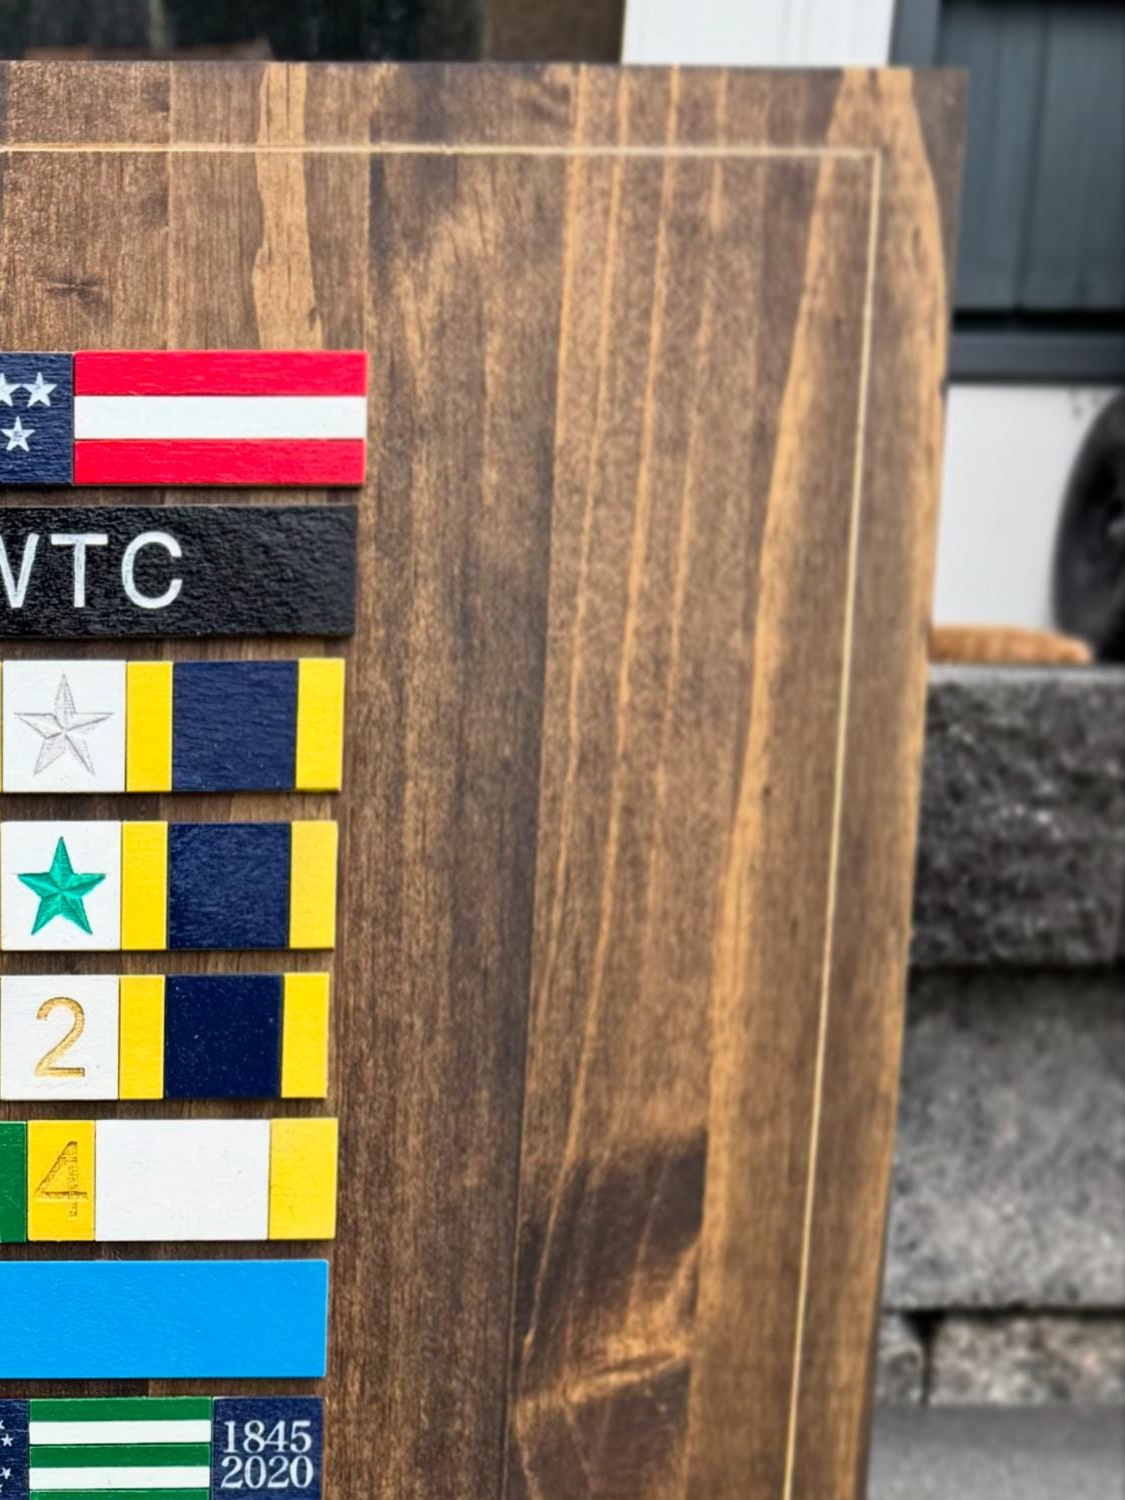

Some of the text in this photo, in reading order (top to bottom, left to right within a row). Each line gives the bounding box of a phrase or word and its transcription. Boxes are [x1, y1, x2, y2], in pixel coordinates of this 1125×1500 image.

[33, 996, 86, 1078] 2
[35, 1140, 89, 1218] 4
[223, 1419, 312, 1453] 1845
[220, 1456, 314, 1489] 2020
